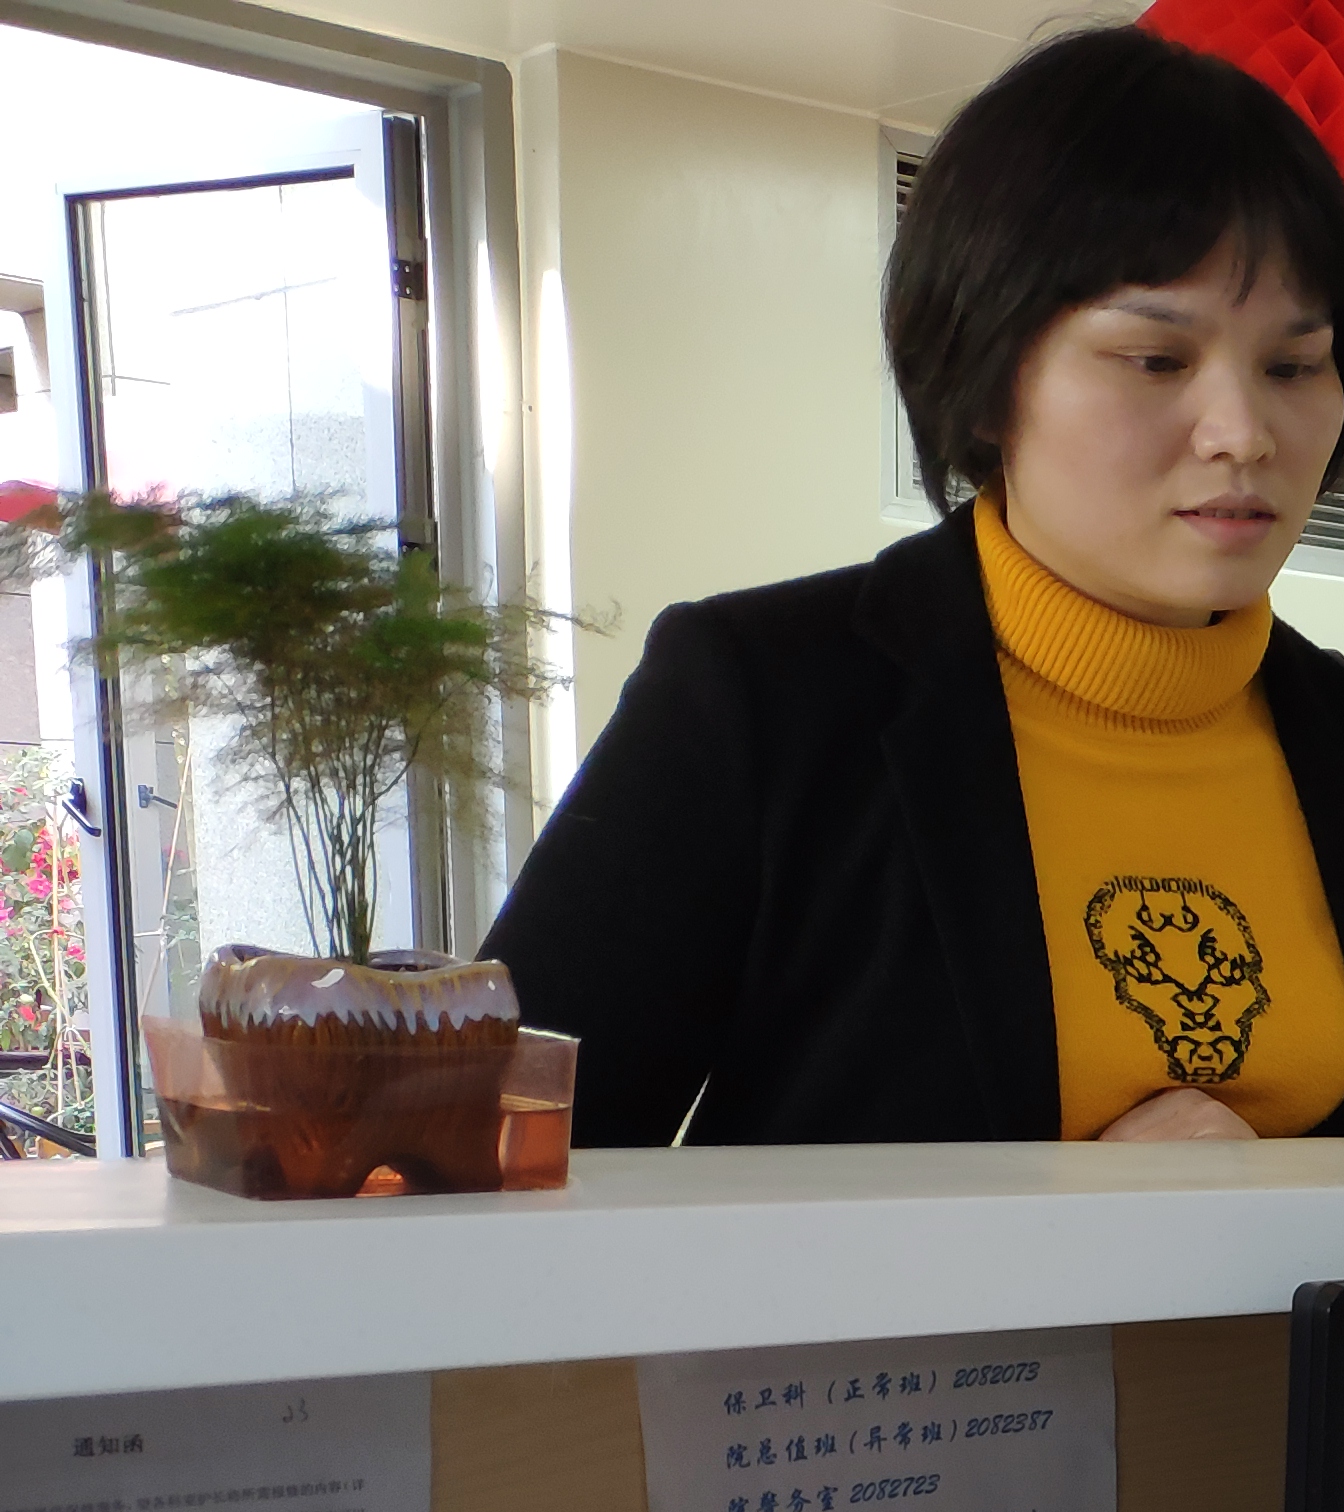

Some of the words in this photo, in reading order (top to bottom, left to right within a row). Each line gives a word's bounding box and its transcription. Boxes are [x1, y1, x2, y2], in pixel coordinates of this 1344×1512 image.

[952, 1361, 1041, 1390] 2082073
[964, 1410, 1054, 1439] 2082387
[849, 1474, 941, 1505] 2082723
